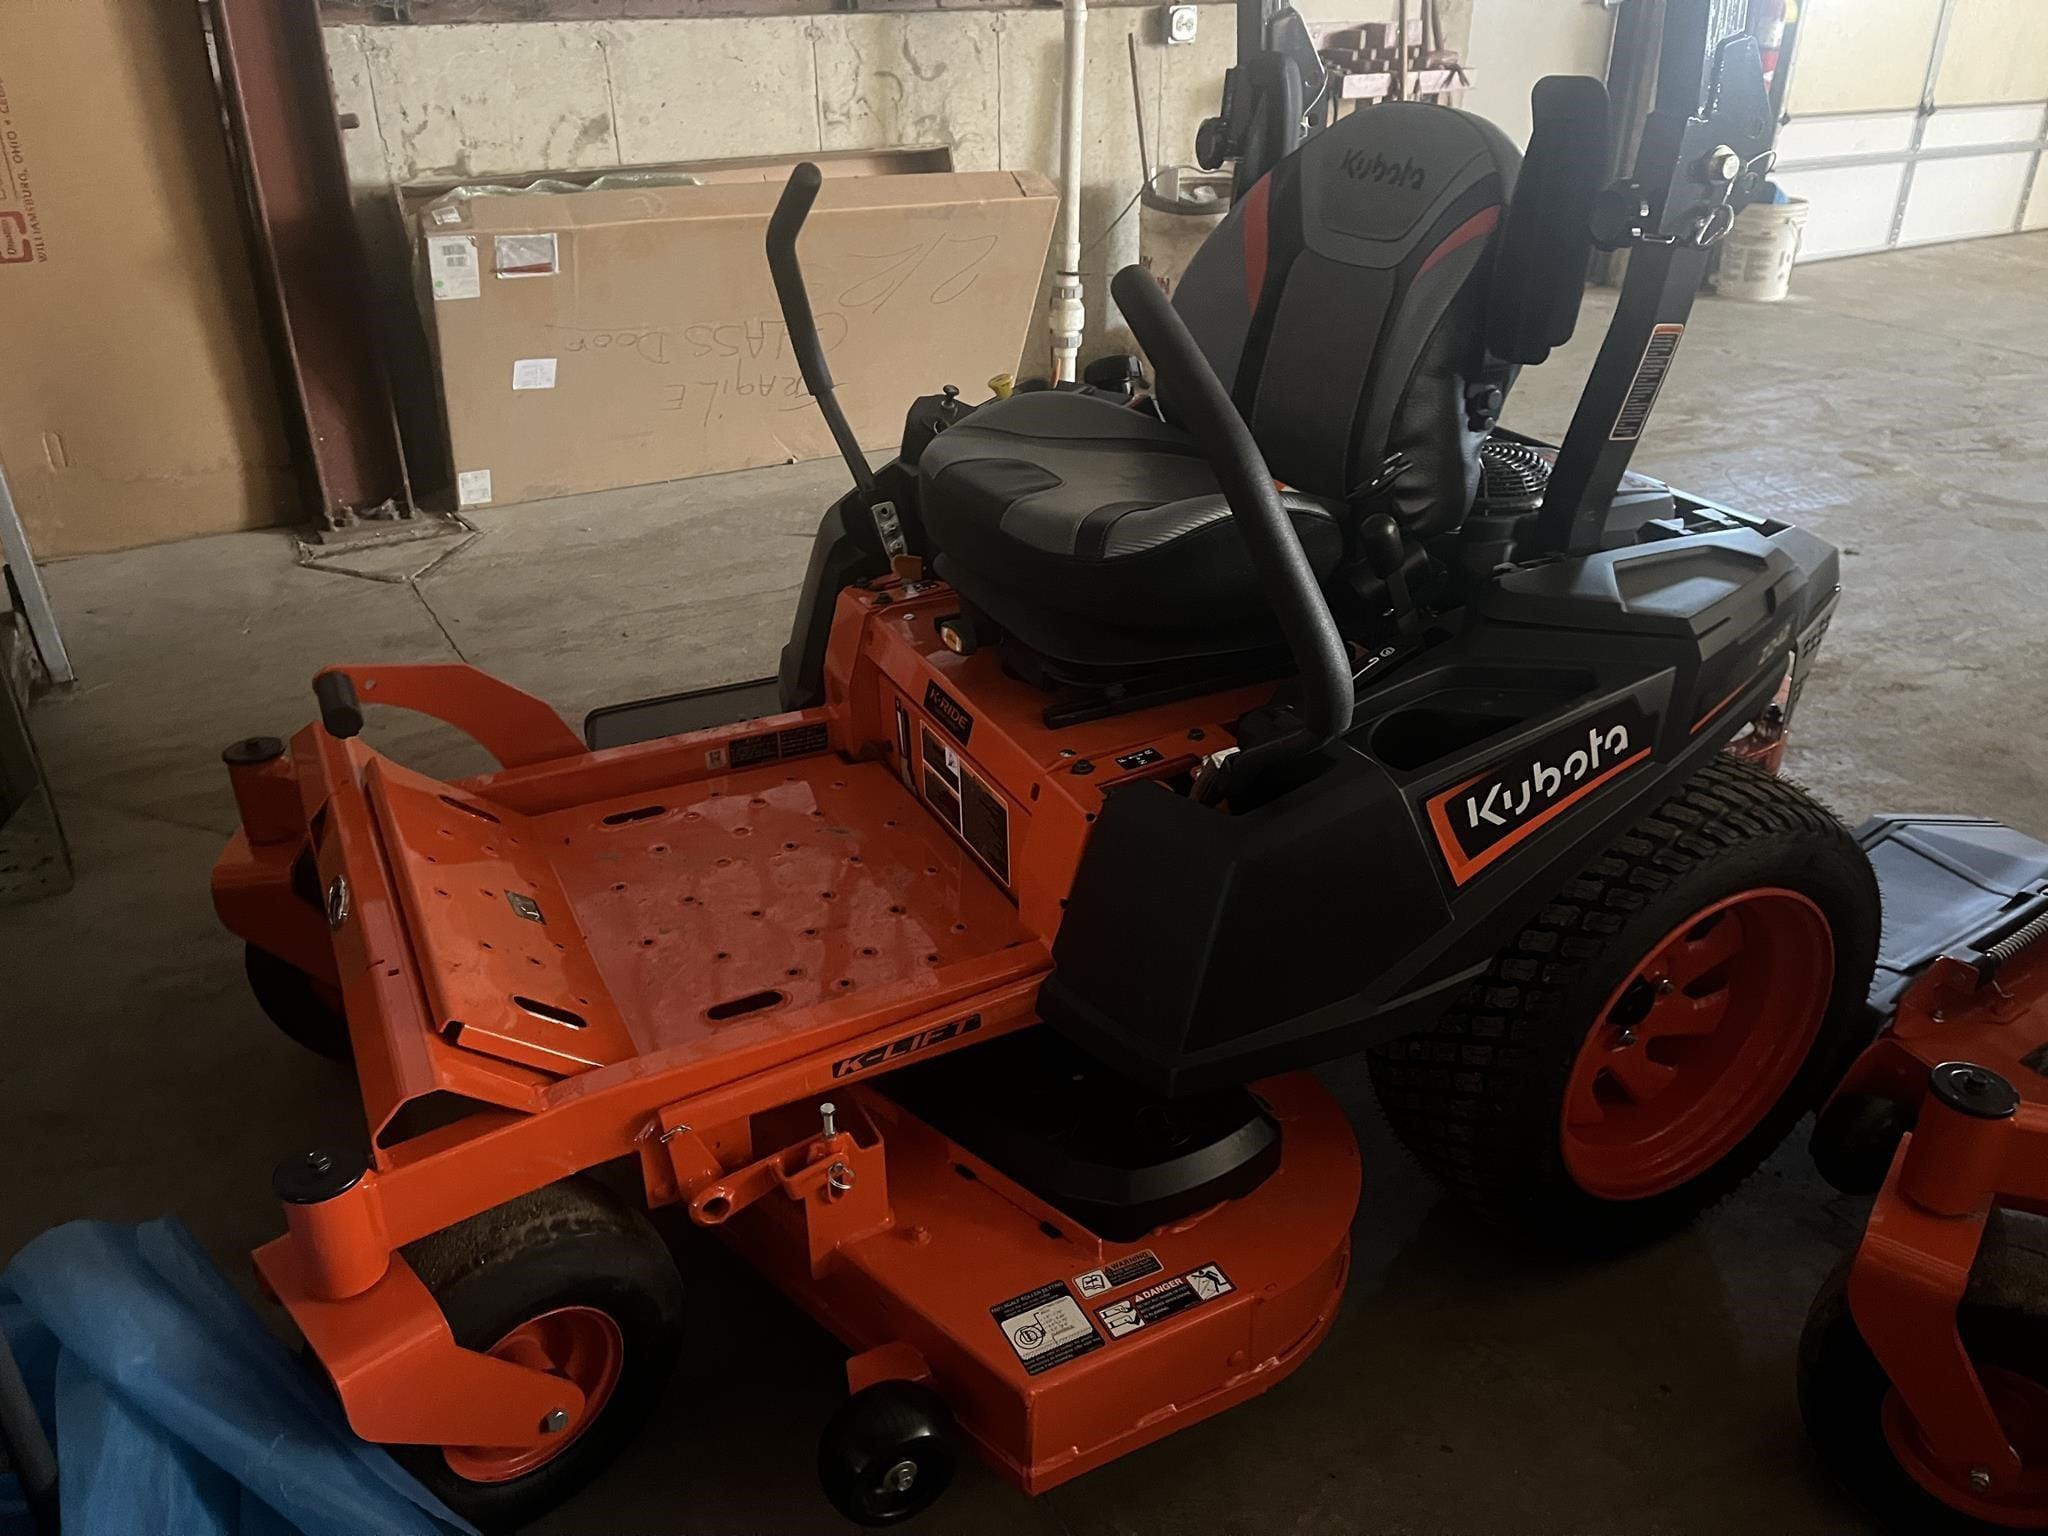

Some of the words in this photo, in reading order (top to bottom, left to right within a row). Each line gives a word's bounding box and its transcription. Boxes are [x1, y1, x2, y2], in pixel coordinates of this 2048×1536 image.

[6, 130, 24, 164] OHIO
[1339, 148, 1426, 190] Kubota
[1466, 724, 1629, 828] Kubota
[837, 1014, 978, 1077] K-LIFT
[1110, 1251, 1150, 1270] WARNING
[1142, 1277, 1184, 1299] DANGER
